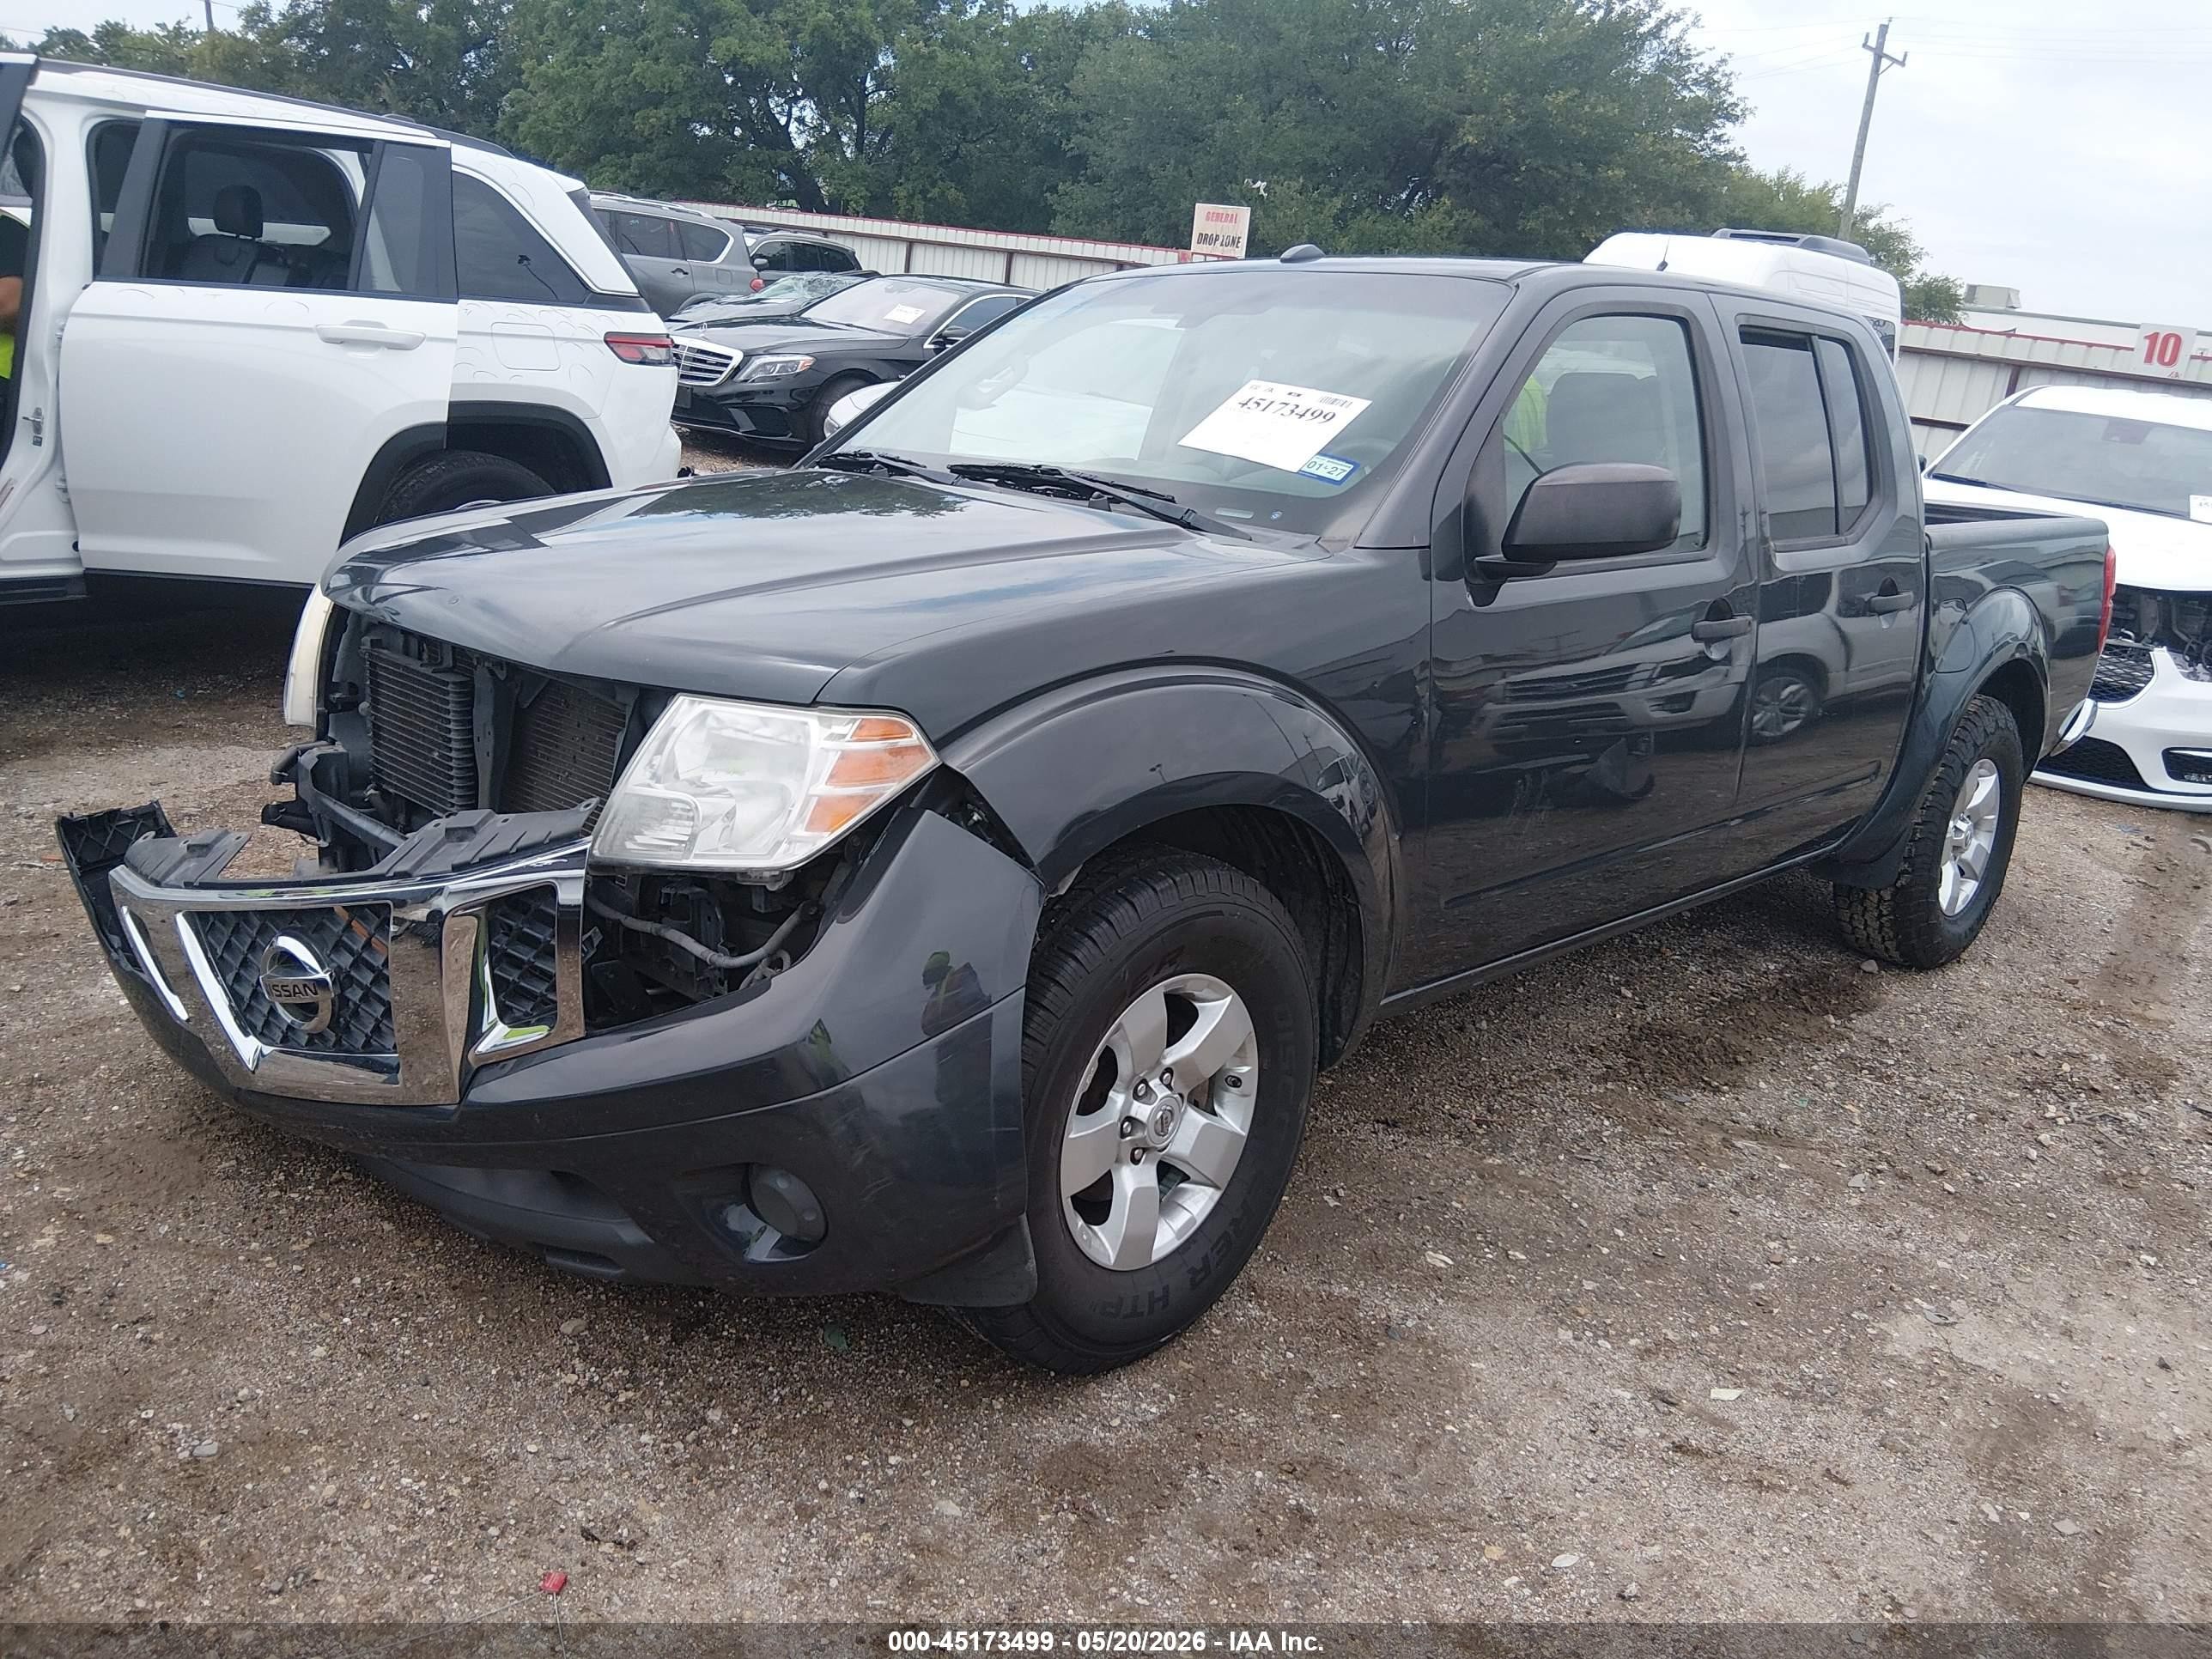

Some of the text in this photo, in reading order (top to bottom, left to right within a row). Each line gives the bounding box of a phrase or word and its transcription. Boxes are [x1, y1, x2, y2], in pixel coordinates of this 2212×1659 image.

[1197, 233, 1242, 248] DROP ZONE
[2143, 331, 2182, 367] 10
[1238, 397, 1336, 424] 45173499
